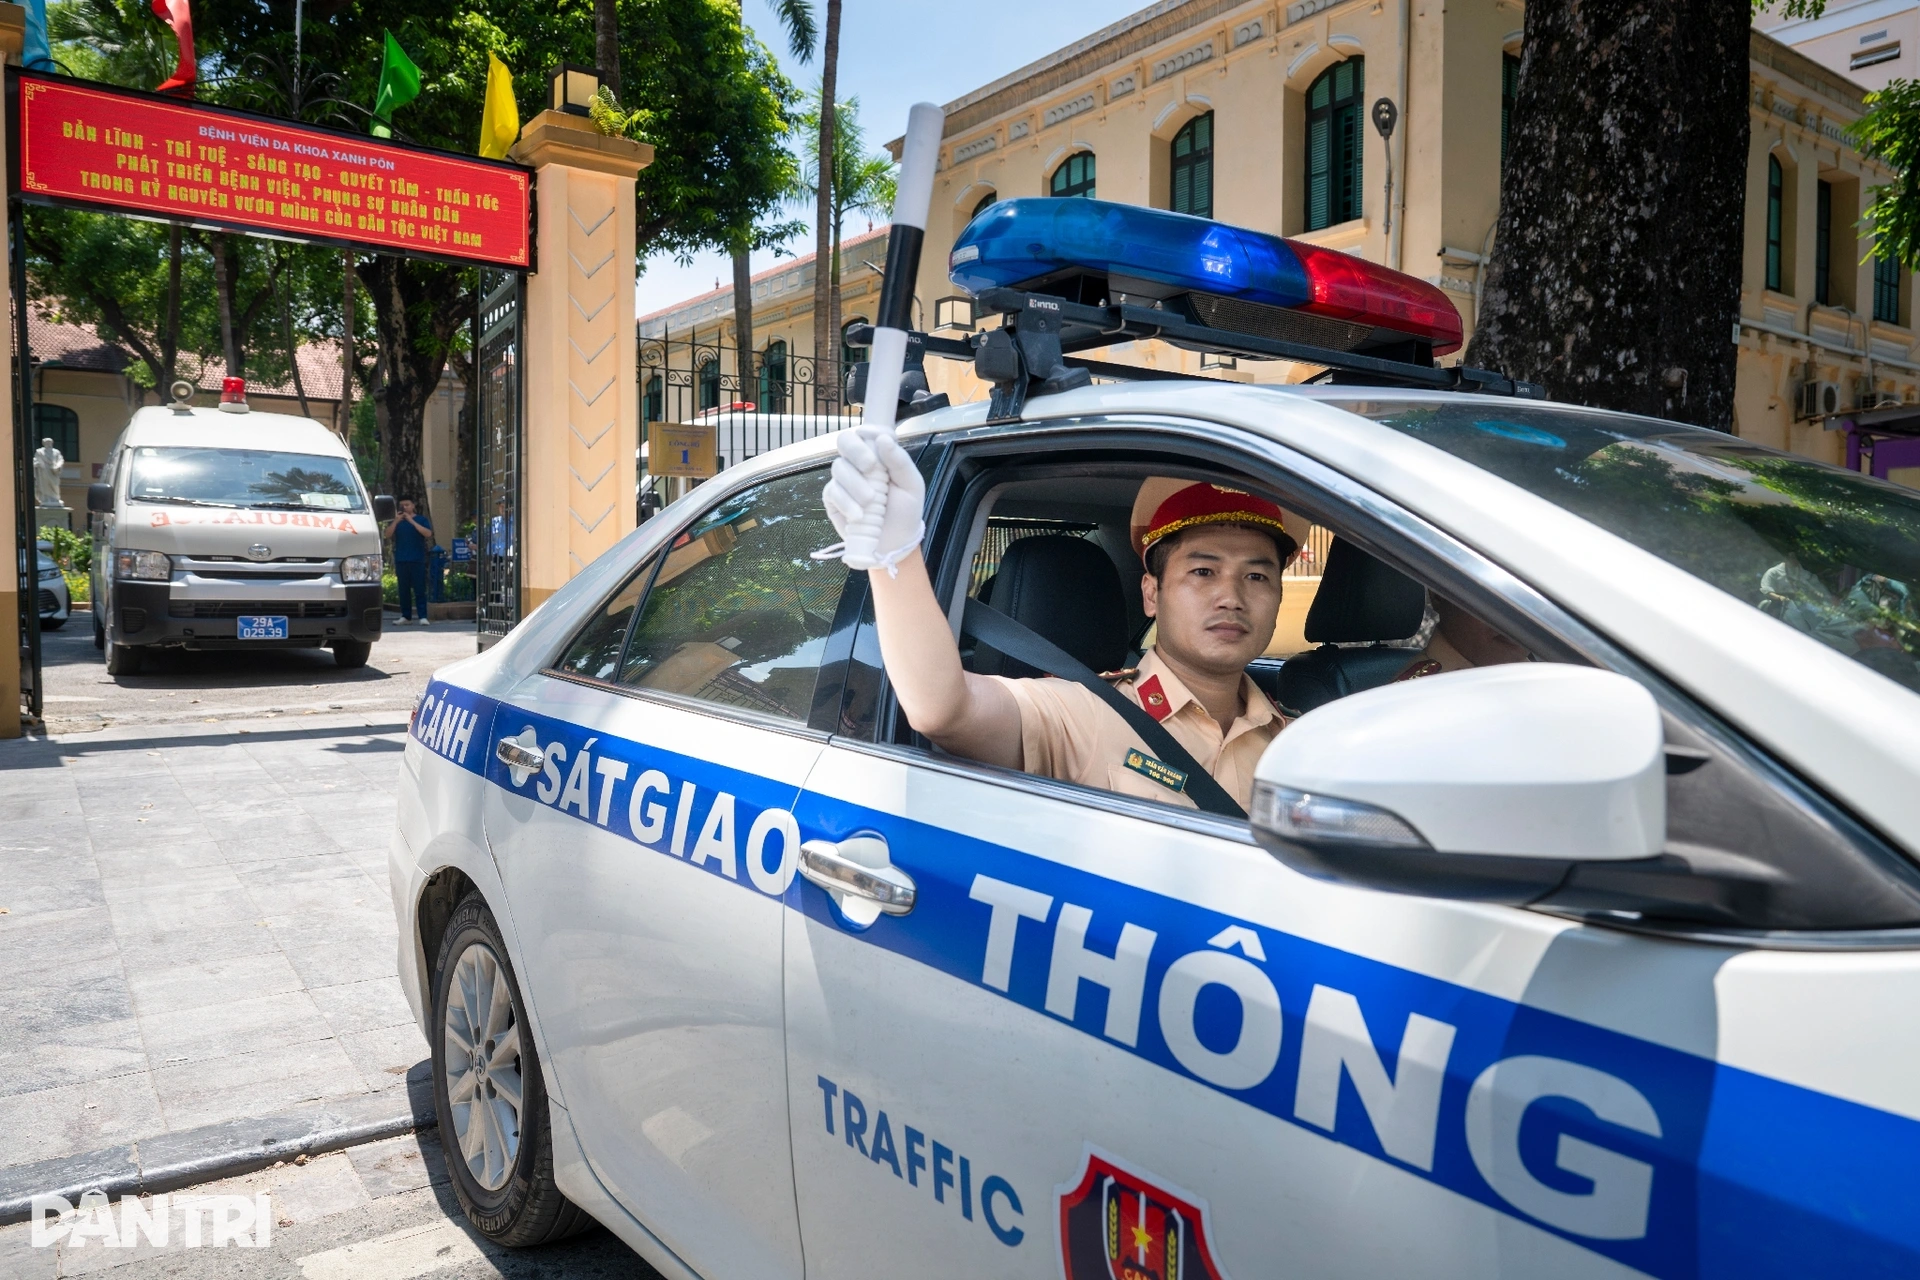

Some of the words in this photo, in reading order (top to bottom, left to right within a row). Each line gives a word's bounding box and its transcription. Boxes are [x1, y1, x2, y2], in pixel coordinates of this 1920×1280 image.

[63, 119, 97, 142] BẢN
[105, 127, 143, 150] LĨNH
[165, 139, 191, 158] TRÍ
[199, 145, 226, 167] TUỆ
[247, 153, 287, 175] SÁNG
[294, 162, 321, 181] TẠO
[340, 170, 384, 191] QUYẾT
[390, 177, 419, 197] TÂM
[199, 125, 235, 142] BỆNH
[239, 133, 269, 148] VIỆN
[273, 141, 290, 151] ĐA
[294, 143, 329, 159] KHOA
[332, 150, 367, 165] XANH
[370, 157, 394, 170] PÔN
[80, 170, 134, 194] TRONG
[168, 184, 228, 208] NGUYÊN
[234, 194, 275, 215] VƯƠN
[357, 213, 386, 233] DÂN
[391, 219, 416, 239] TỘC
[421, 224, 449, 244] VIỆT
[453, 230, 482, 248] NAM
[117, 153, 159, 175] PHÁT
[220, 169, 260, 190] BỆNH
[391, 199, 428, 219] NHÂN
[433, 205, 460, 223] DÂN
[243, 627, 283, 638] 029.39
[252, 617, 274, 628] 29A
[536, 737, 629, 827] SÁT
[628, 769, 801, 896] GIAO
[968, 873, 1663, 1241] THÔNG
[817, 1075, 1025, 1248] TRAFFIC
